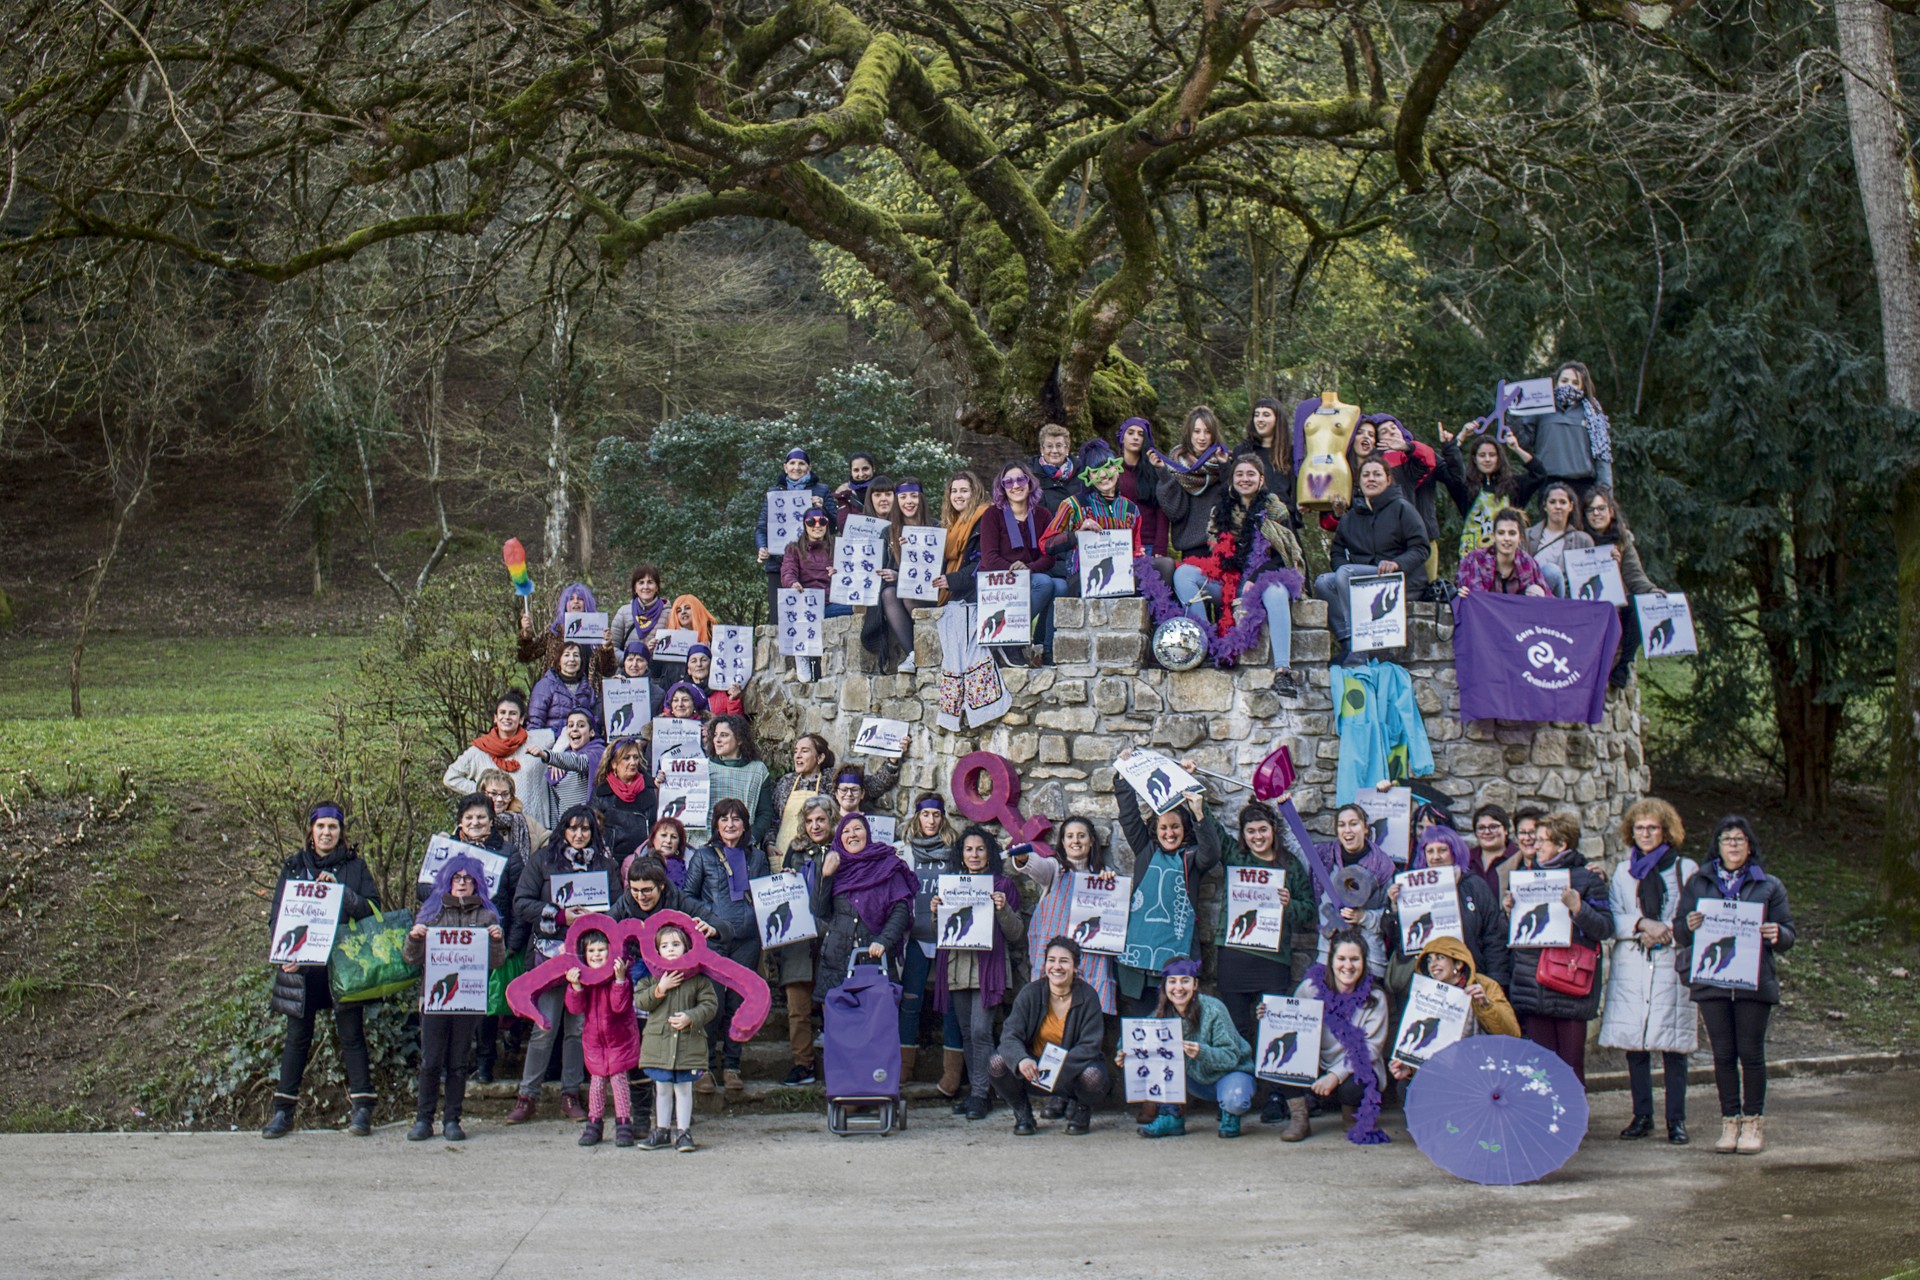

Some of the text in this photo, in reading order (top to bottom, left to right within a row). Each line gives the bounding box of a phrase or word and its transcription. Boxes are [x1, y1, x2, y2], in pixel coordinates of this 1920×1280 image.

[988, 572, 1016, 586] M8
[672, 760, 696, 773] M8
[771, 874, 784, 882] M8
[1240, 868, 1269, 884] M8
[1408, 870, 1438, 887] M8
[296, 883, 328, 898] M8
[1087, 876, 1116, 891] M8
[440, 930, 472, 944] M8
[1286, 998, 1300, 1006] M8
